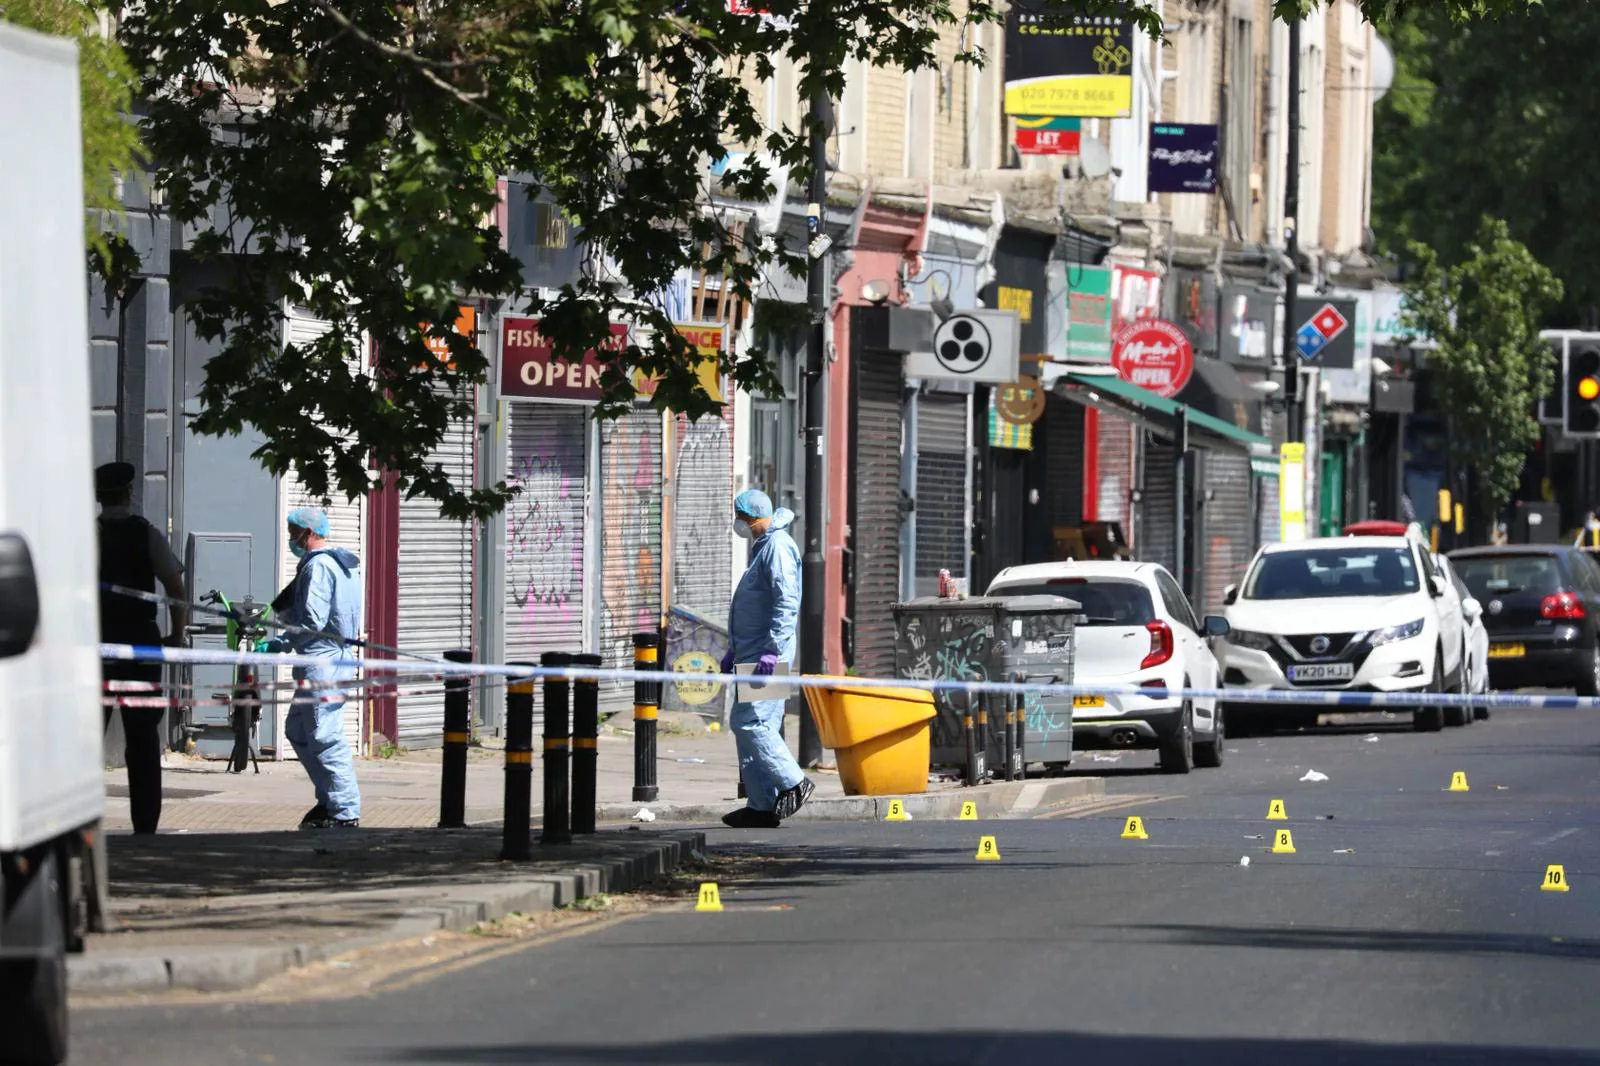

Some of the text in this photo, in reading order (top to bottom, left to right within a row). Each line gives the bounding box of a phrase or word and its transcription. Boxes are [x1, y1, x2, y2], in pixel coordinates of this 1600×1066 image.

[1036, 131, 1060, 144] LET
[507, 329, 544, 348] FISH
[520, 360, 604, 388] OPEN
[1132, 367, 1170, 384] OPEN
[892, 804, 898, 814] 5
[965, 806, 971, 815] 3
[1273, 804, 1280, 814] 4
[1130, 821, 1136, 831] 6
[1281, 834, 1288, 845] 8
[984, 841, 991, 851] 9
[1548, 872, 1560, 883] 10
[704, 892, 714, 903] 11
